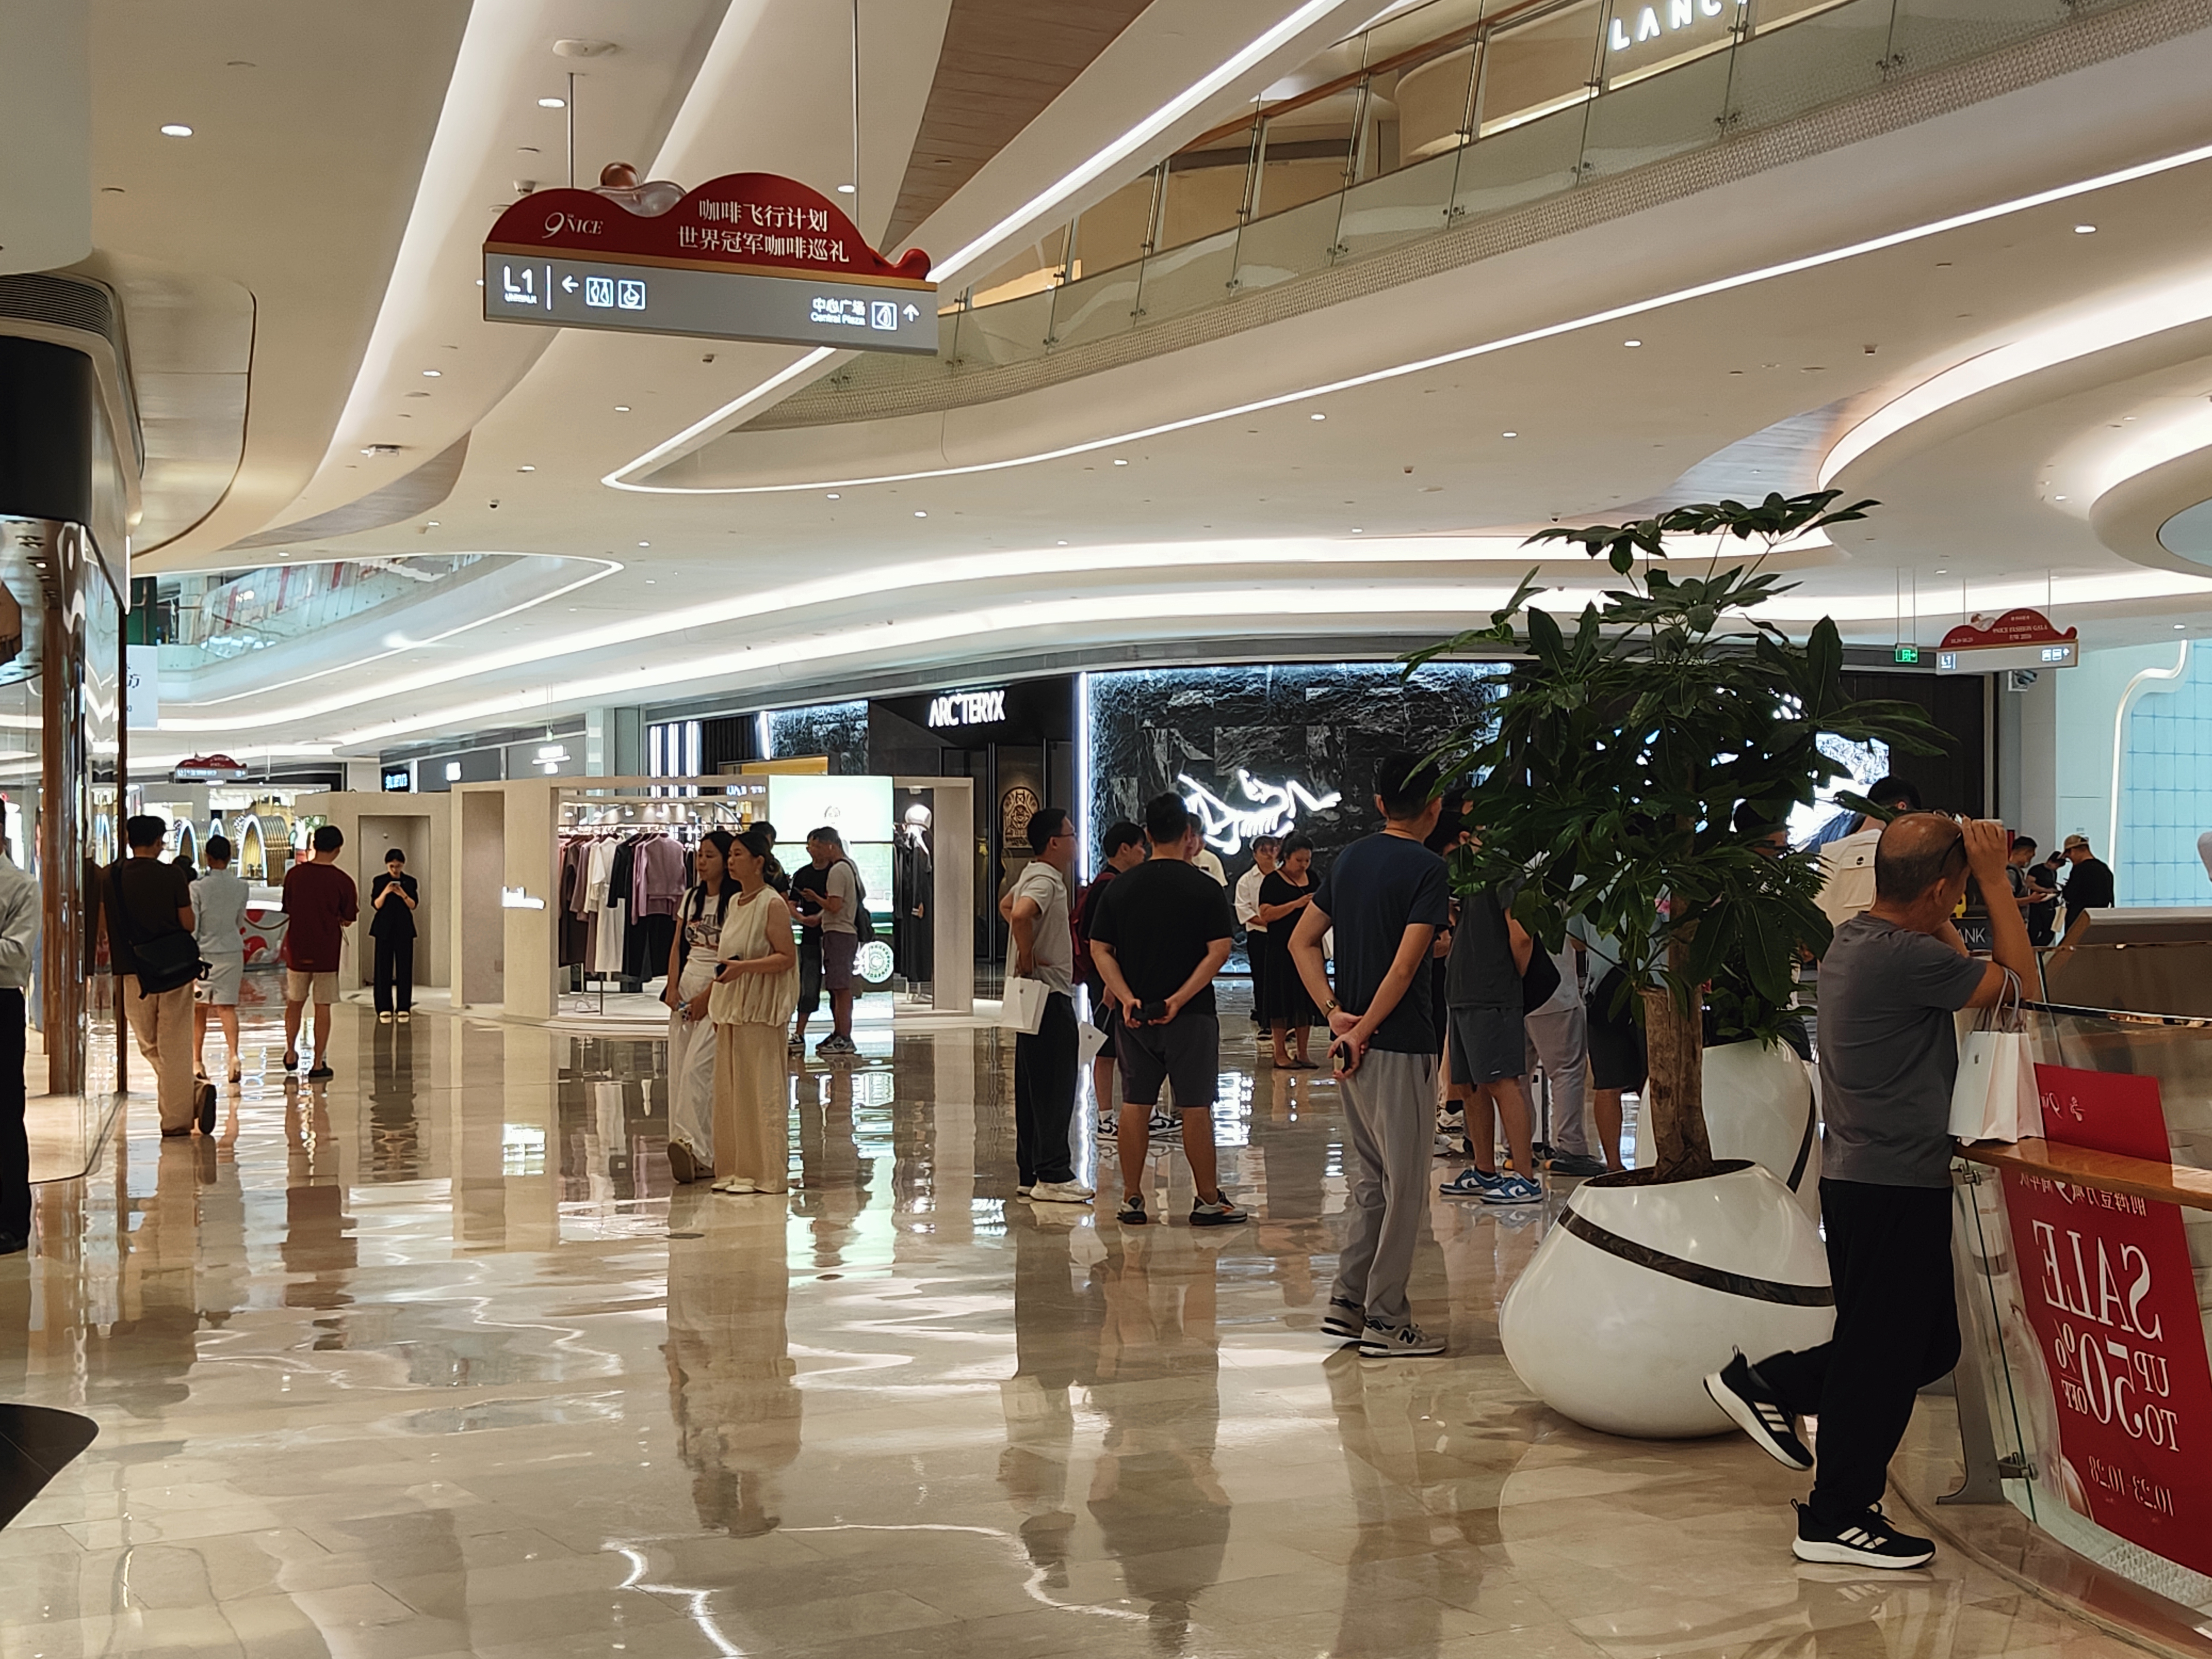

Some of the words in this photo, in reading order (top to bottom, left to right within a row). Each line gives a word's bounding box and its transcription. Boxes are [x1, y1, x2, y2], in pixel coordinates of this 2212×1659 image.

[1608, 0, 1748, 51] LANC
[699, 199, 828, 232] 咖啡飞行计划
[677, 225, 849, 262] 世界冠军咖啡巡礼
[504, 265, 532, 294] L1
[811, 312, 841, 324] Central
[842, 314, 866, 326] Plaza
[812, 297, 866, 316] 中心广场
